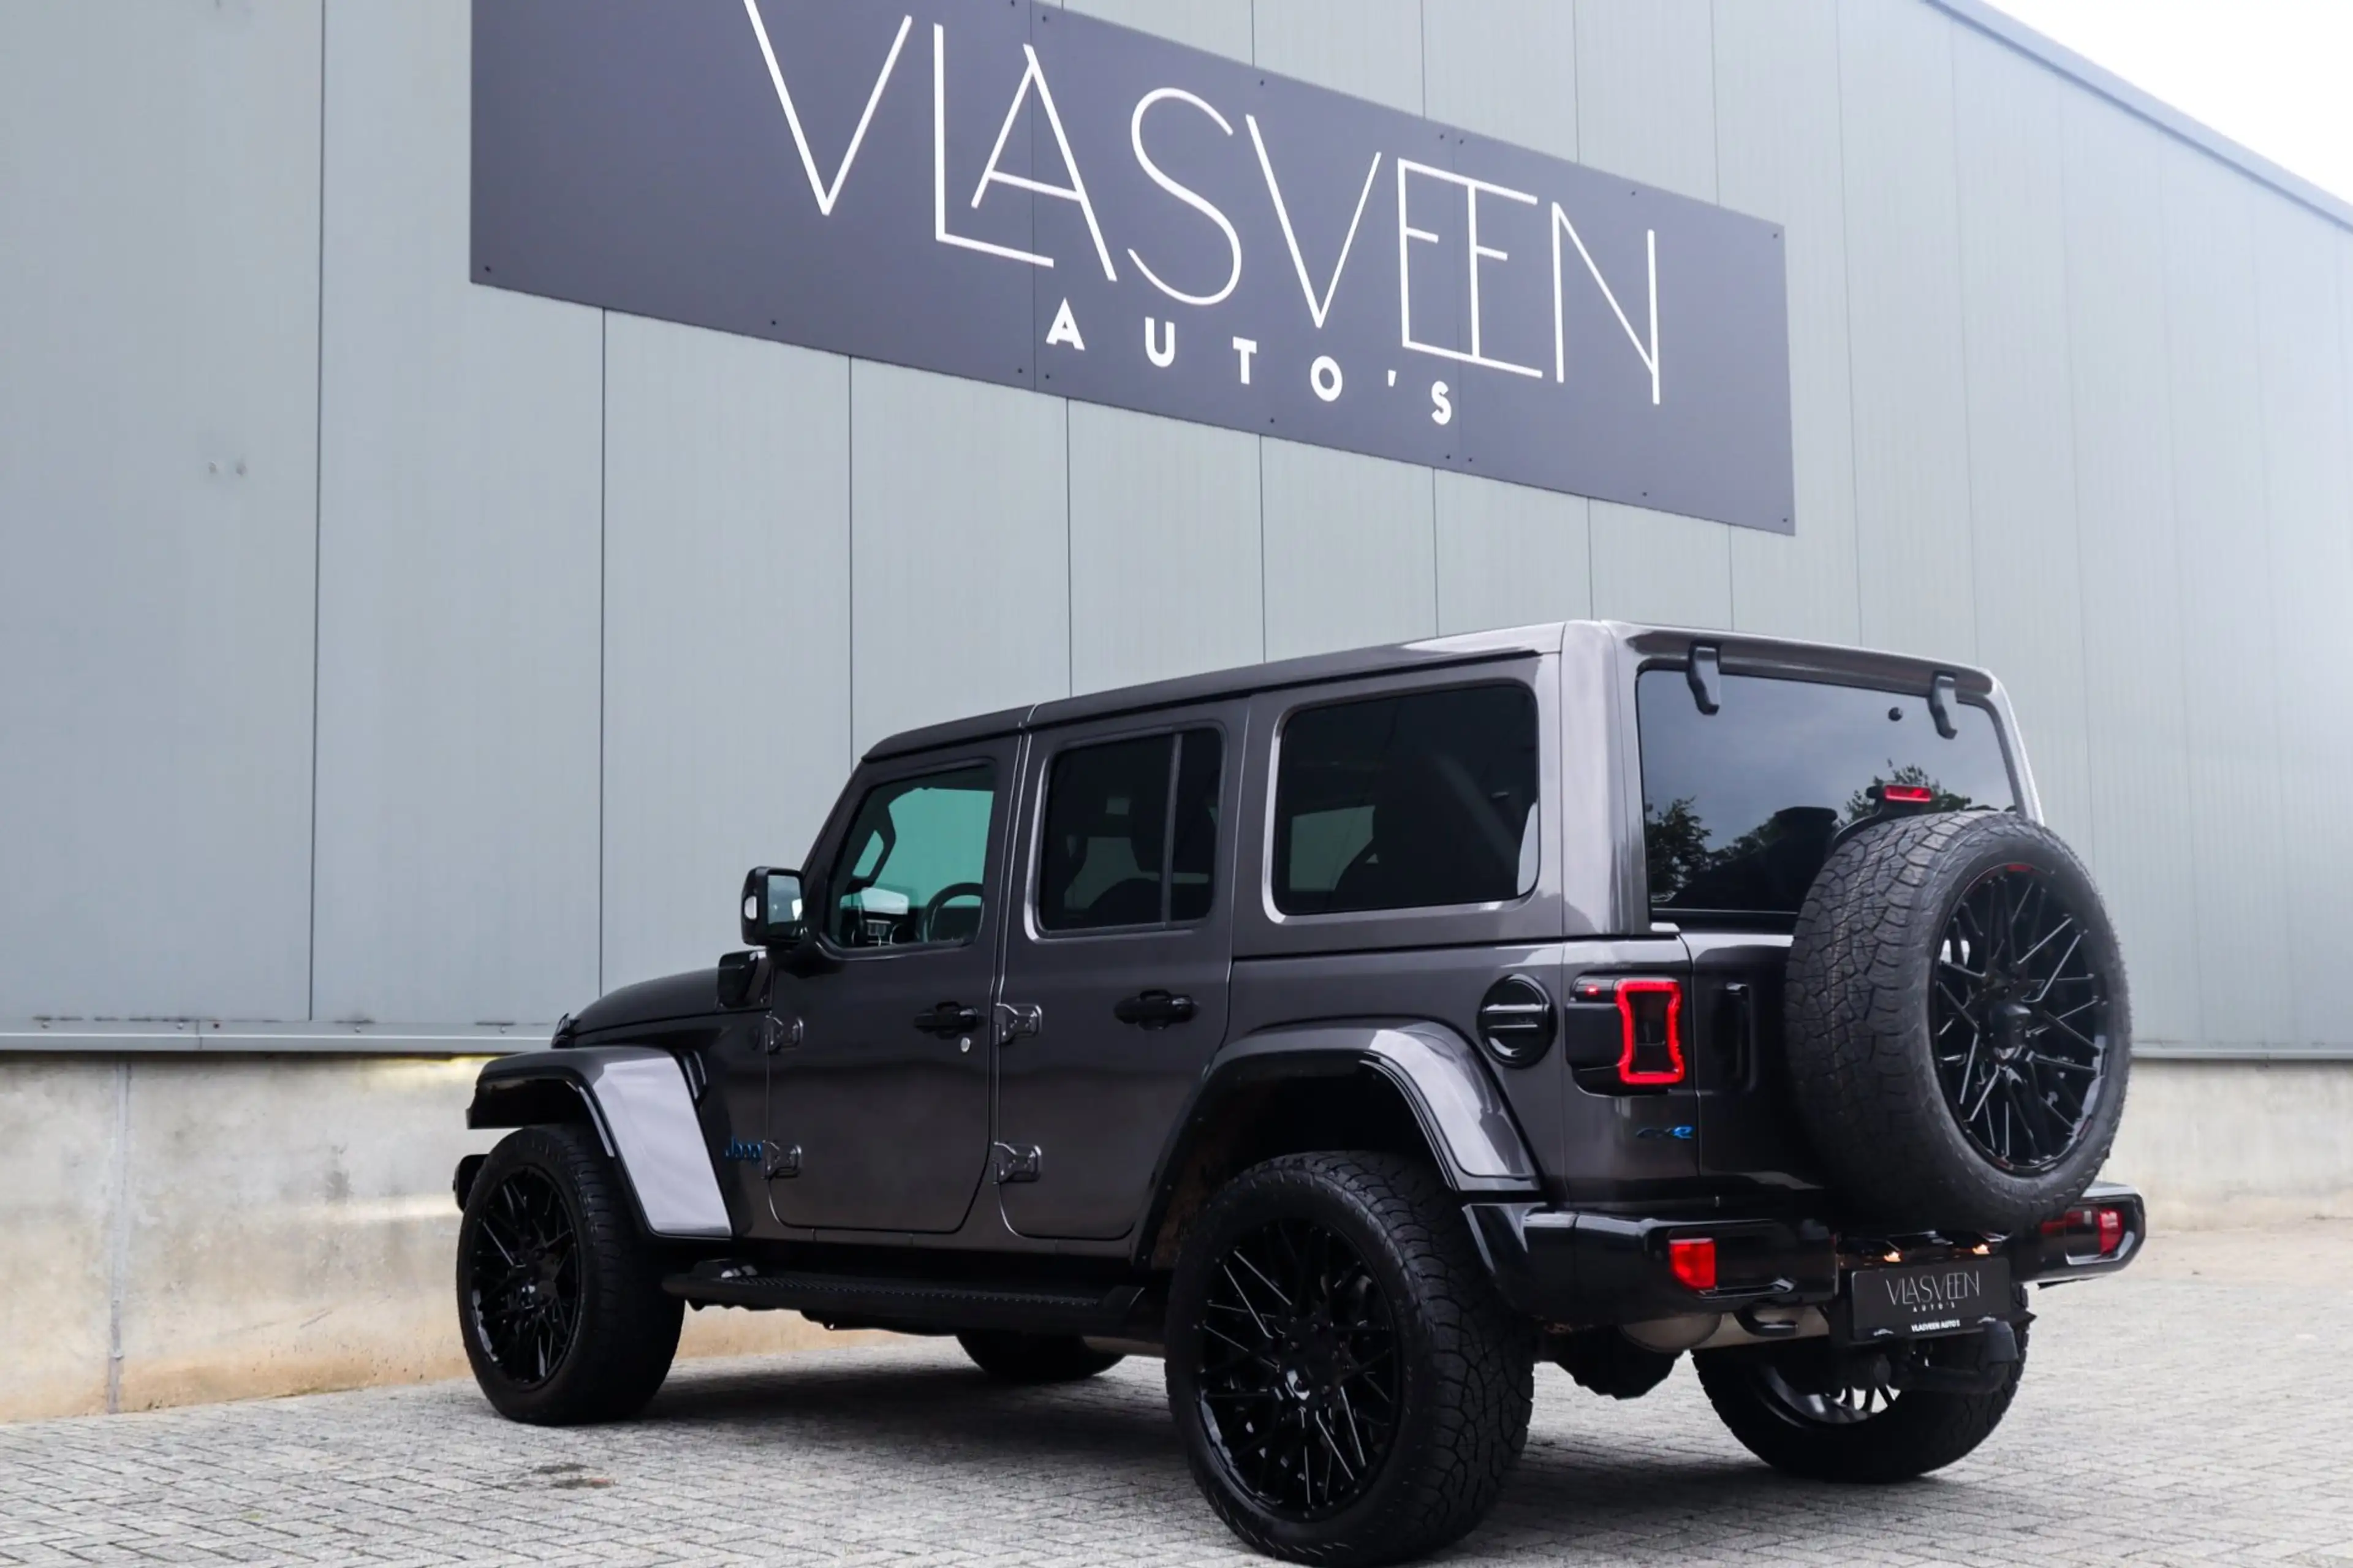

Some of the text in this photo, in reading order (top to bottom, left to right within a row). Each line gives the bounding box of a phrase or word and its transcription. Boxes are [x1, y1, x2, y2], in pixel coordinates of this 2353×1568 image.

[744, 0, 1661, 405] VLASVEEN
[1046, 298, 1452, 425] AUTO'S
[1885, 1270, 1980, 1305] VLASVEEN
